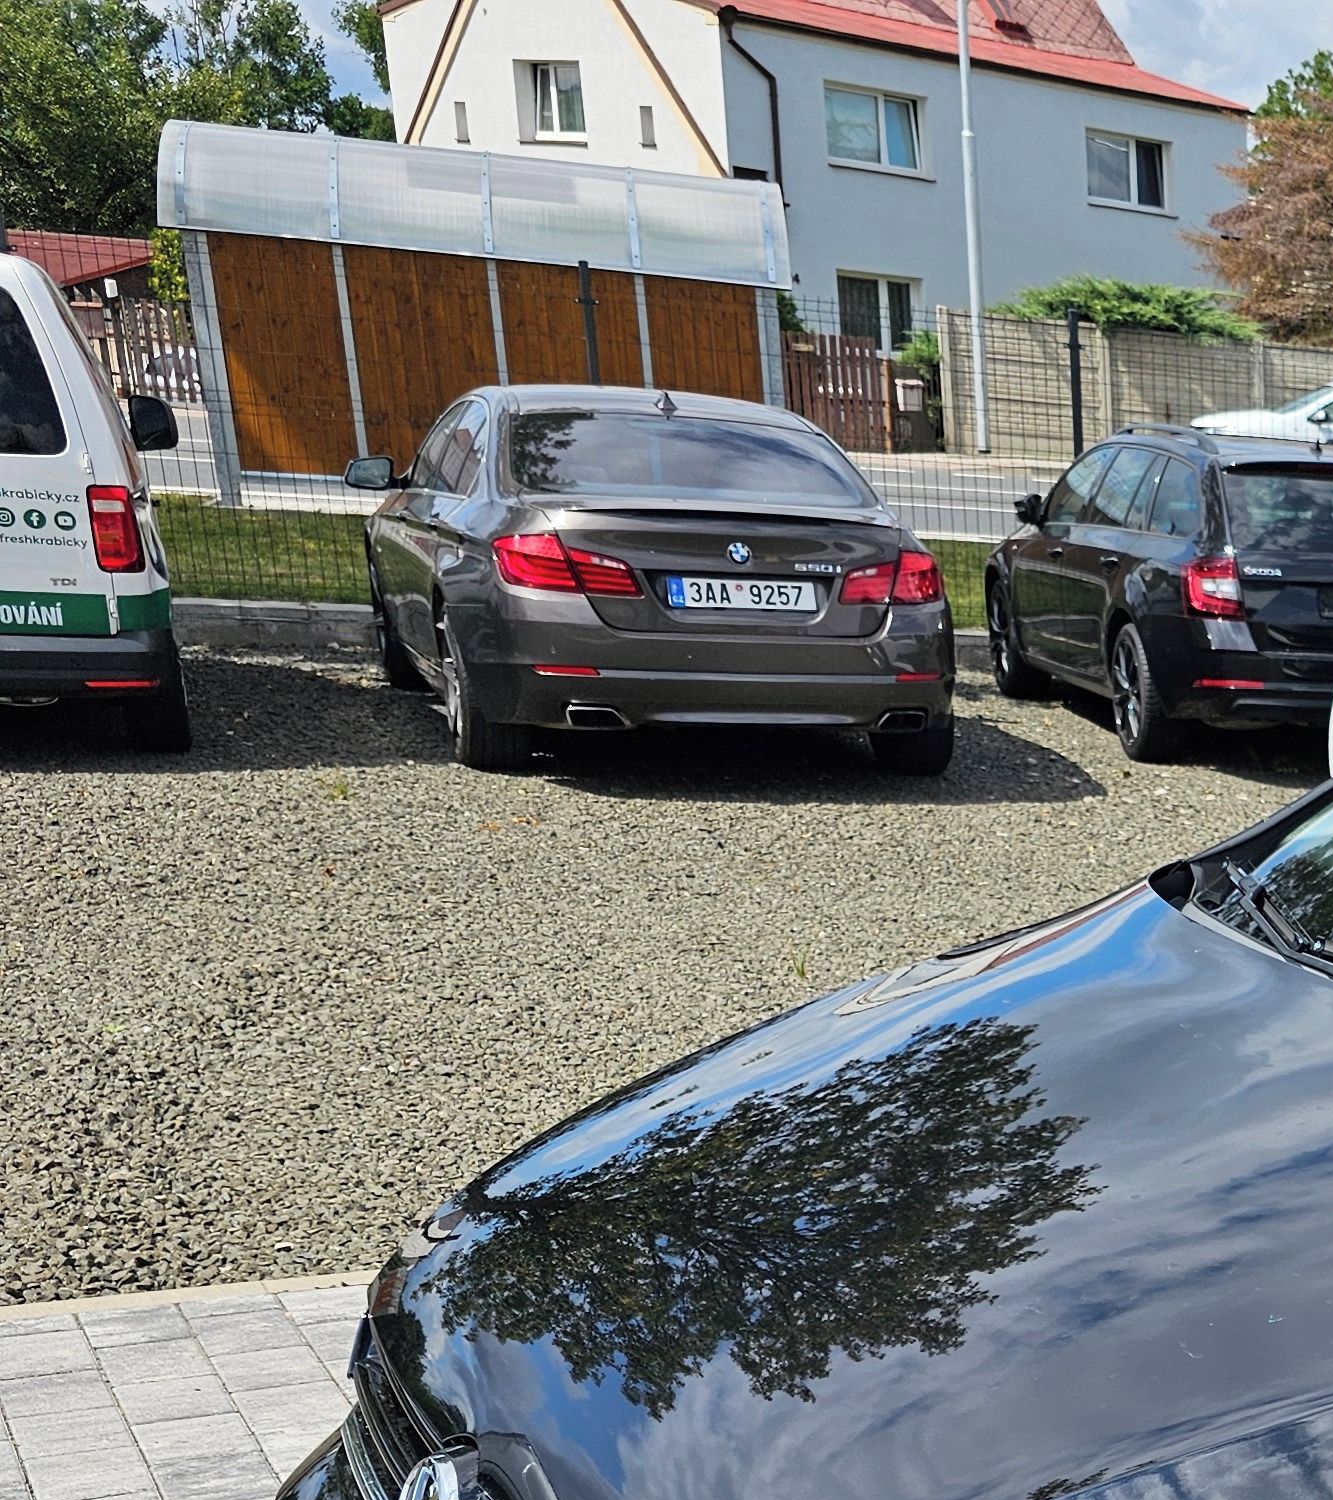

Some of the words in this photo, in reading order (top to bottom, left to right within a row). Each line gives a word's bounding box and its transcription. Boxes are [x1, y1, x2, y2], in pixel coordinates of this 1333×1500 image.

[0, 488, 80, 504] krabicky.cz
[689, 582, 732, 604] 3AA
[749, 584, 803, 606] 9257
